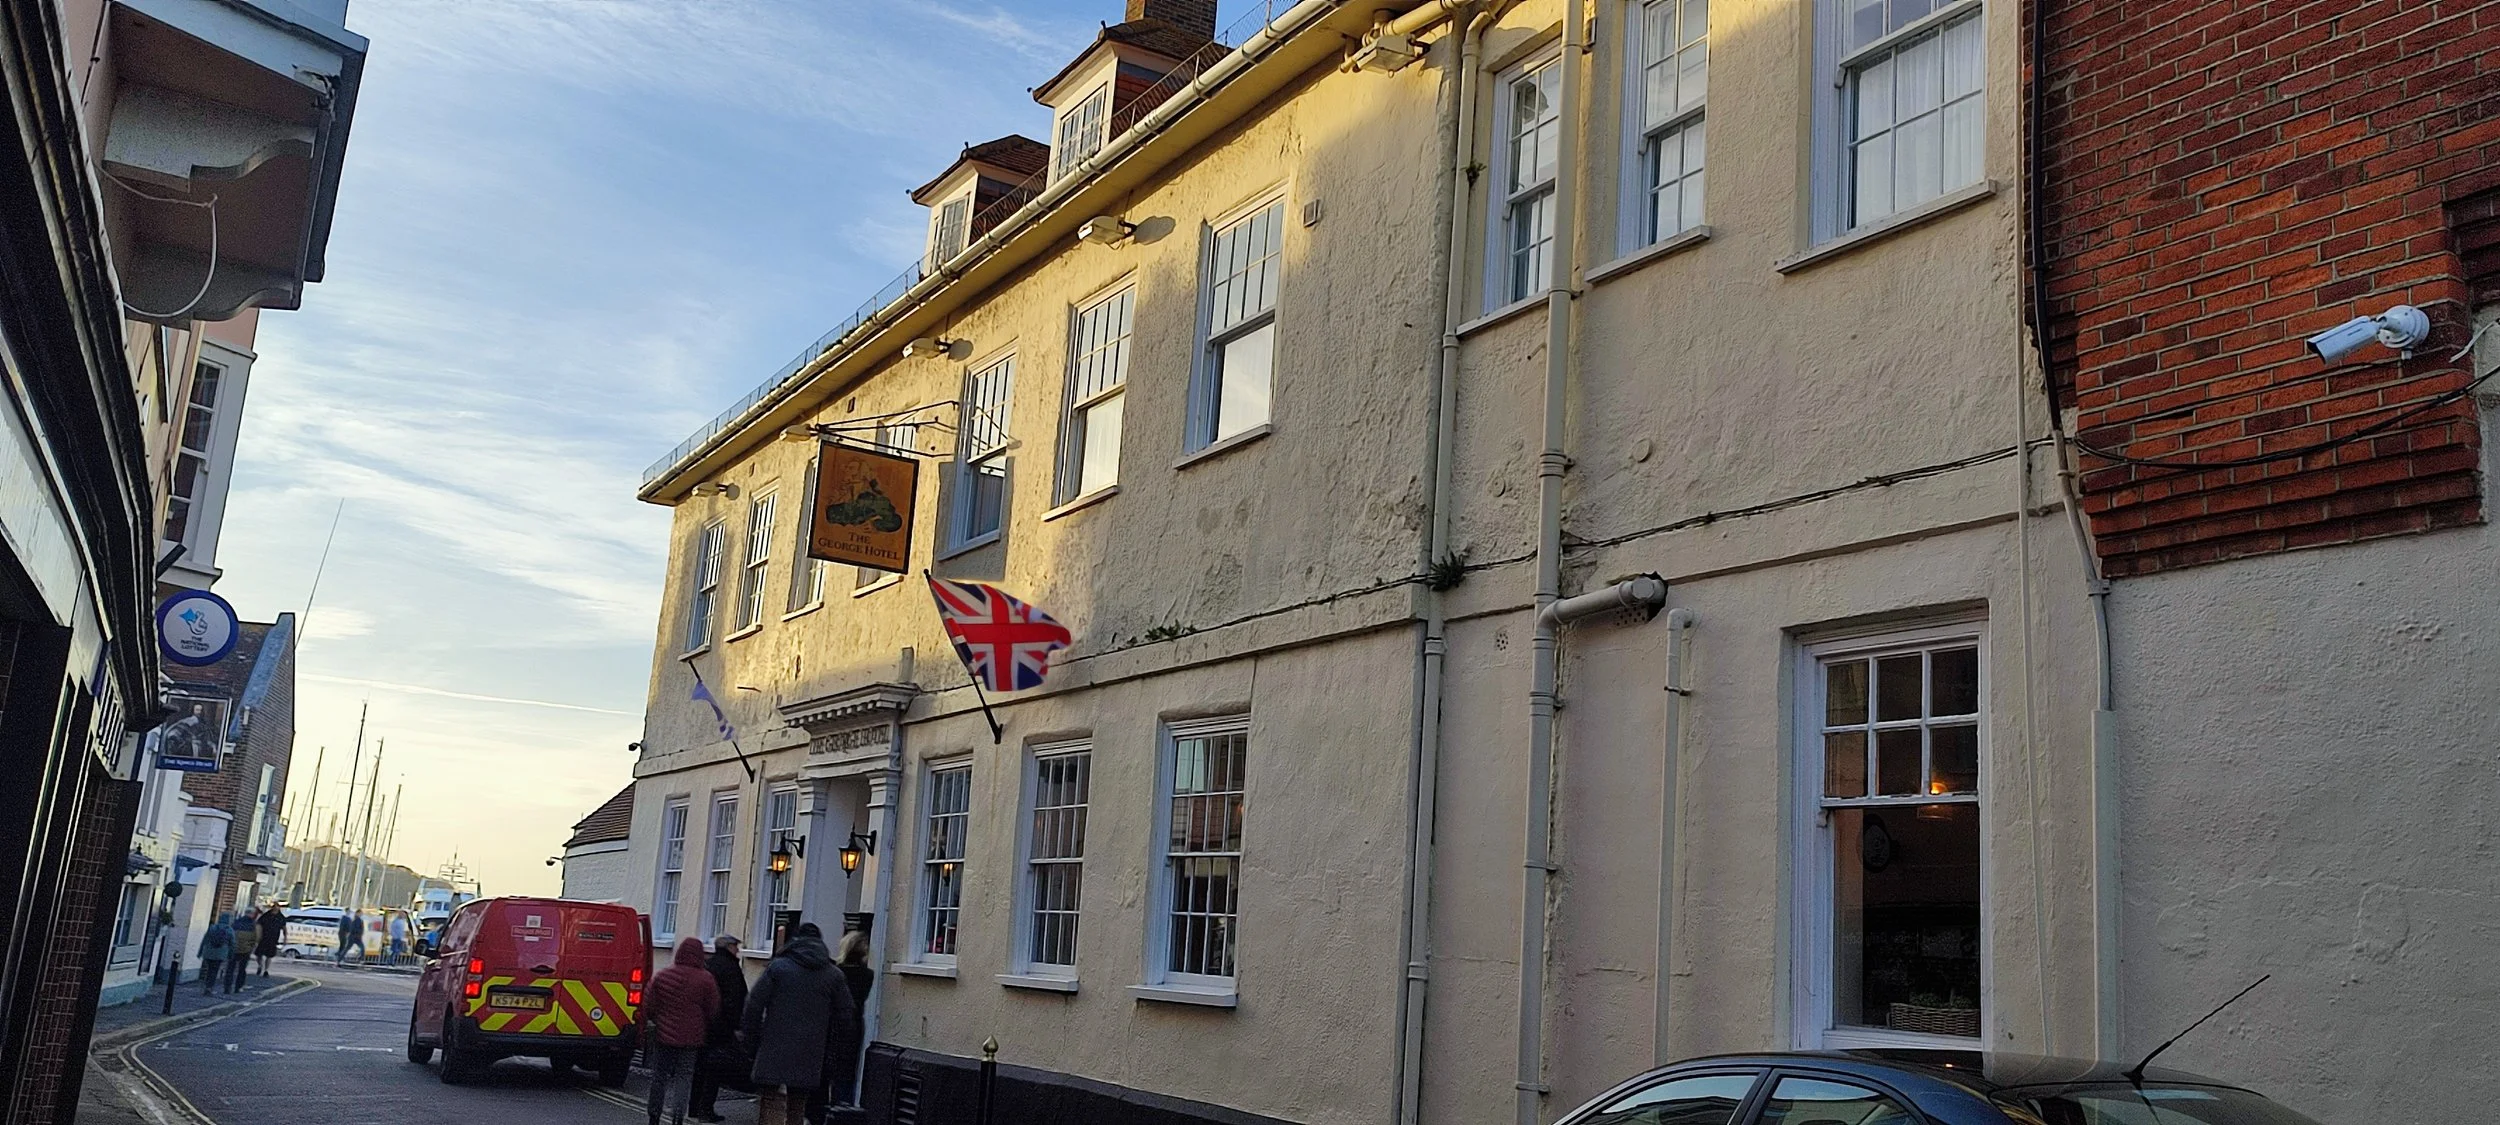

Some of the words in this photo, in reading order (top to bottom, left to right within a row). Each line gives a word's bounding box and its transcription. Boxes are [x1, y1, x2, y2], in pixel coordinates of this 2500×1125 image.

[847, 531, 872, 544] THE
[818, 537, 863, 554] GEORGE
[864, 545, 899, 560] HOTEL
[180, 639, 210, 649] NATIONAL
[181, 644, 208, 652] LOTTERY
[808, 737, 825, 755] THE
[513, 927, 534, 937] Royal
[535, 928, 551, 937] Mail
[495, 996, 521, 1006] KS74
